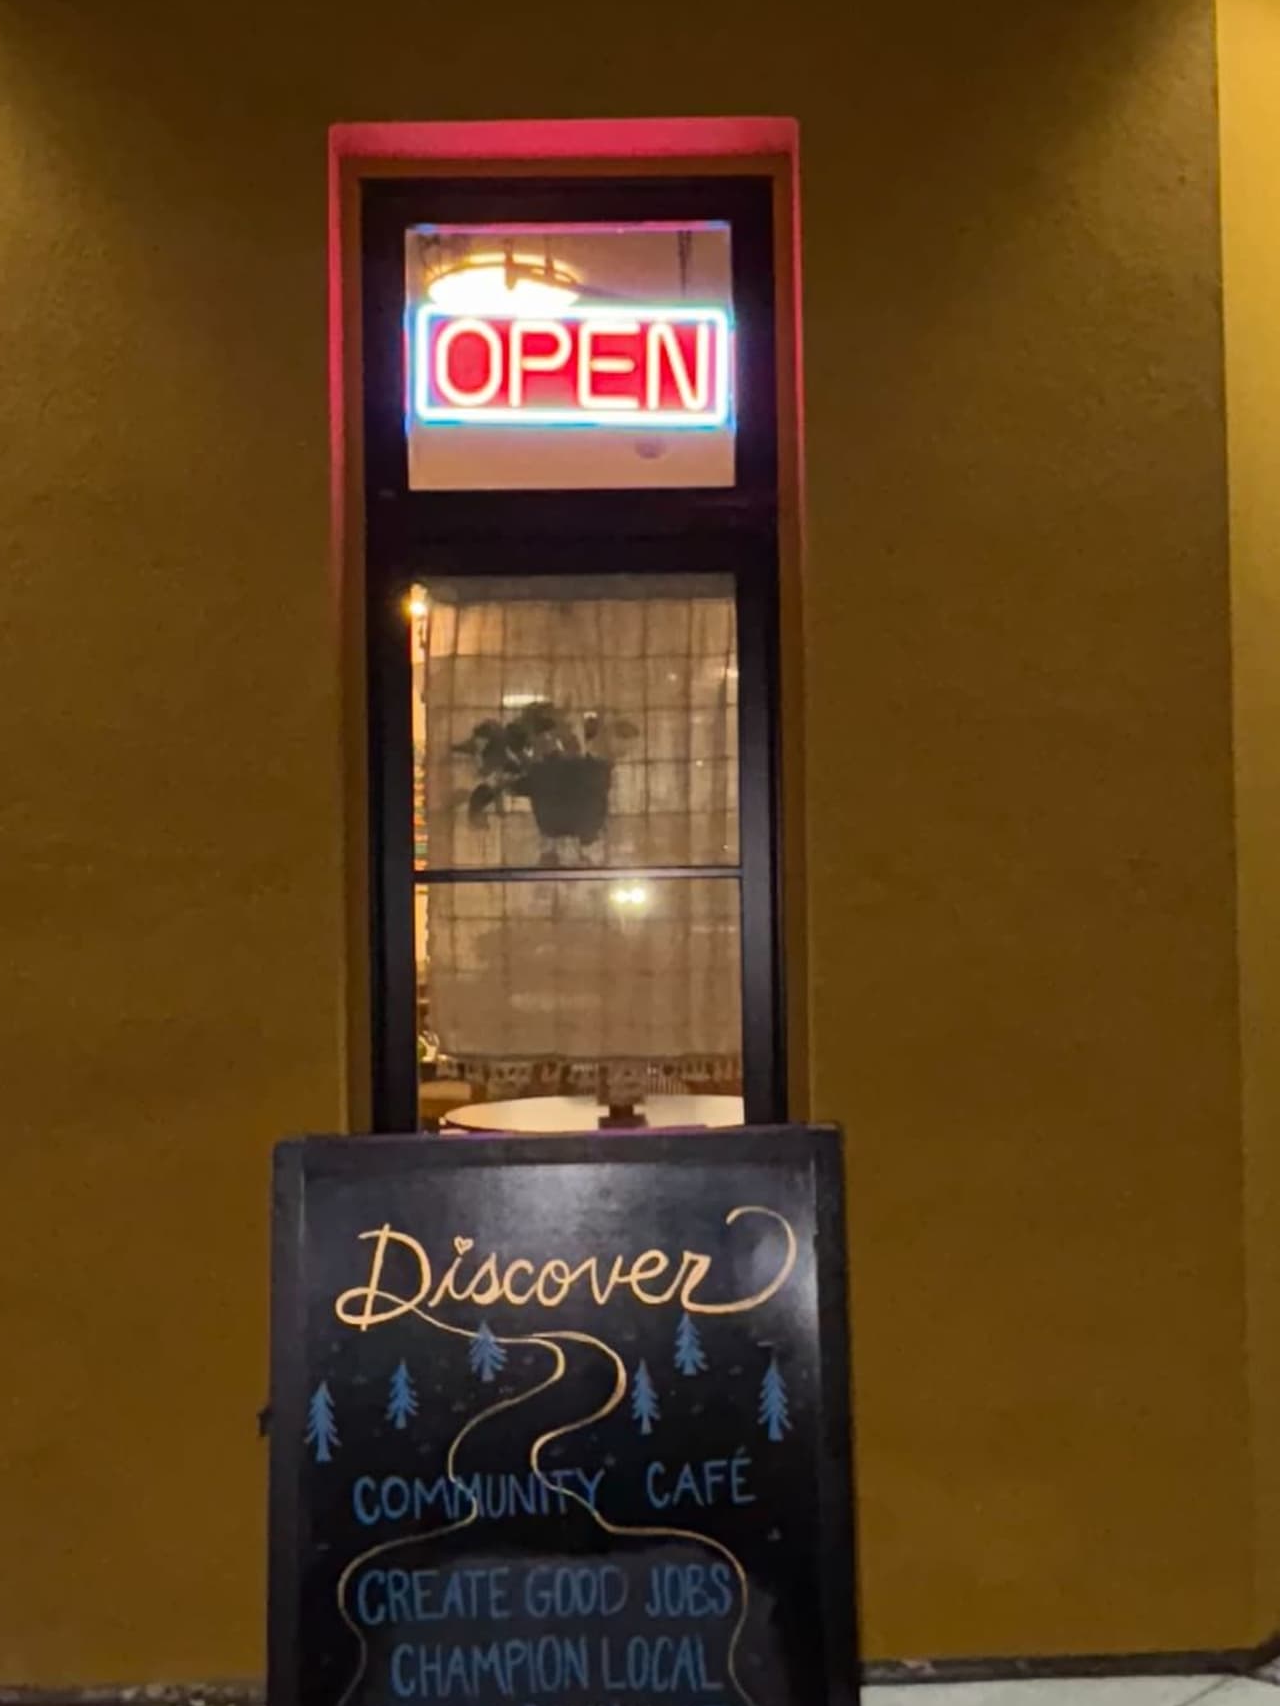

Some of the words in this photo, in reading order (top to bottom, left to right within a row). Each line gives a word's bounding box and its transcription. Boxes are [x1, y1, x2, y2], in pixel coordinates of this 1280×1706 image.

[434, 317, 712, 411] OPEN
[335, 1206, 798, 1332] Discover
[352, 1467, 606, 1526] COMMUNITY
[646, 1446, 757, 1510] CAFÉ
[357, 1565, 511, 1625] CREATE
[524, 1564, 628, 1617] GOOD
[644, 1565, 733, 1618] JOBS
[390, 1634, 589, 1699] CHAMPION
[601, 1633, 724, 1693] LOCAL
